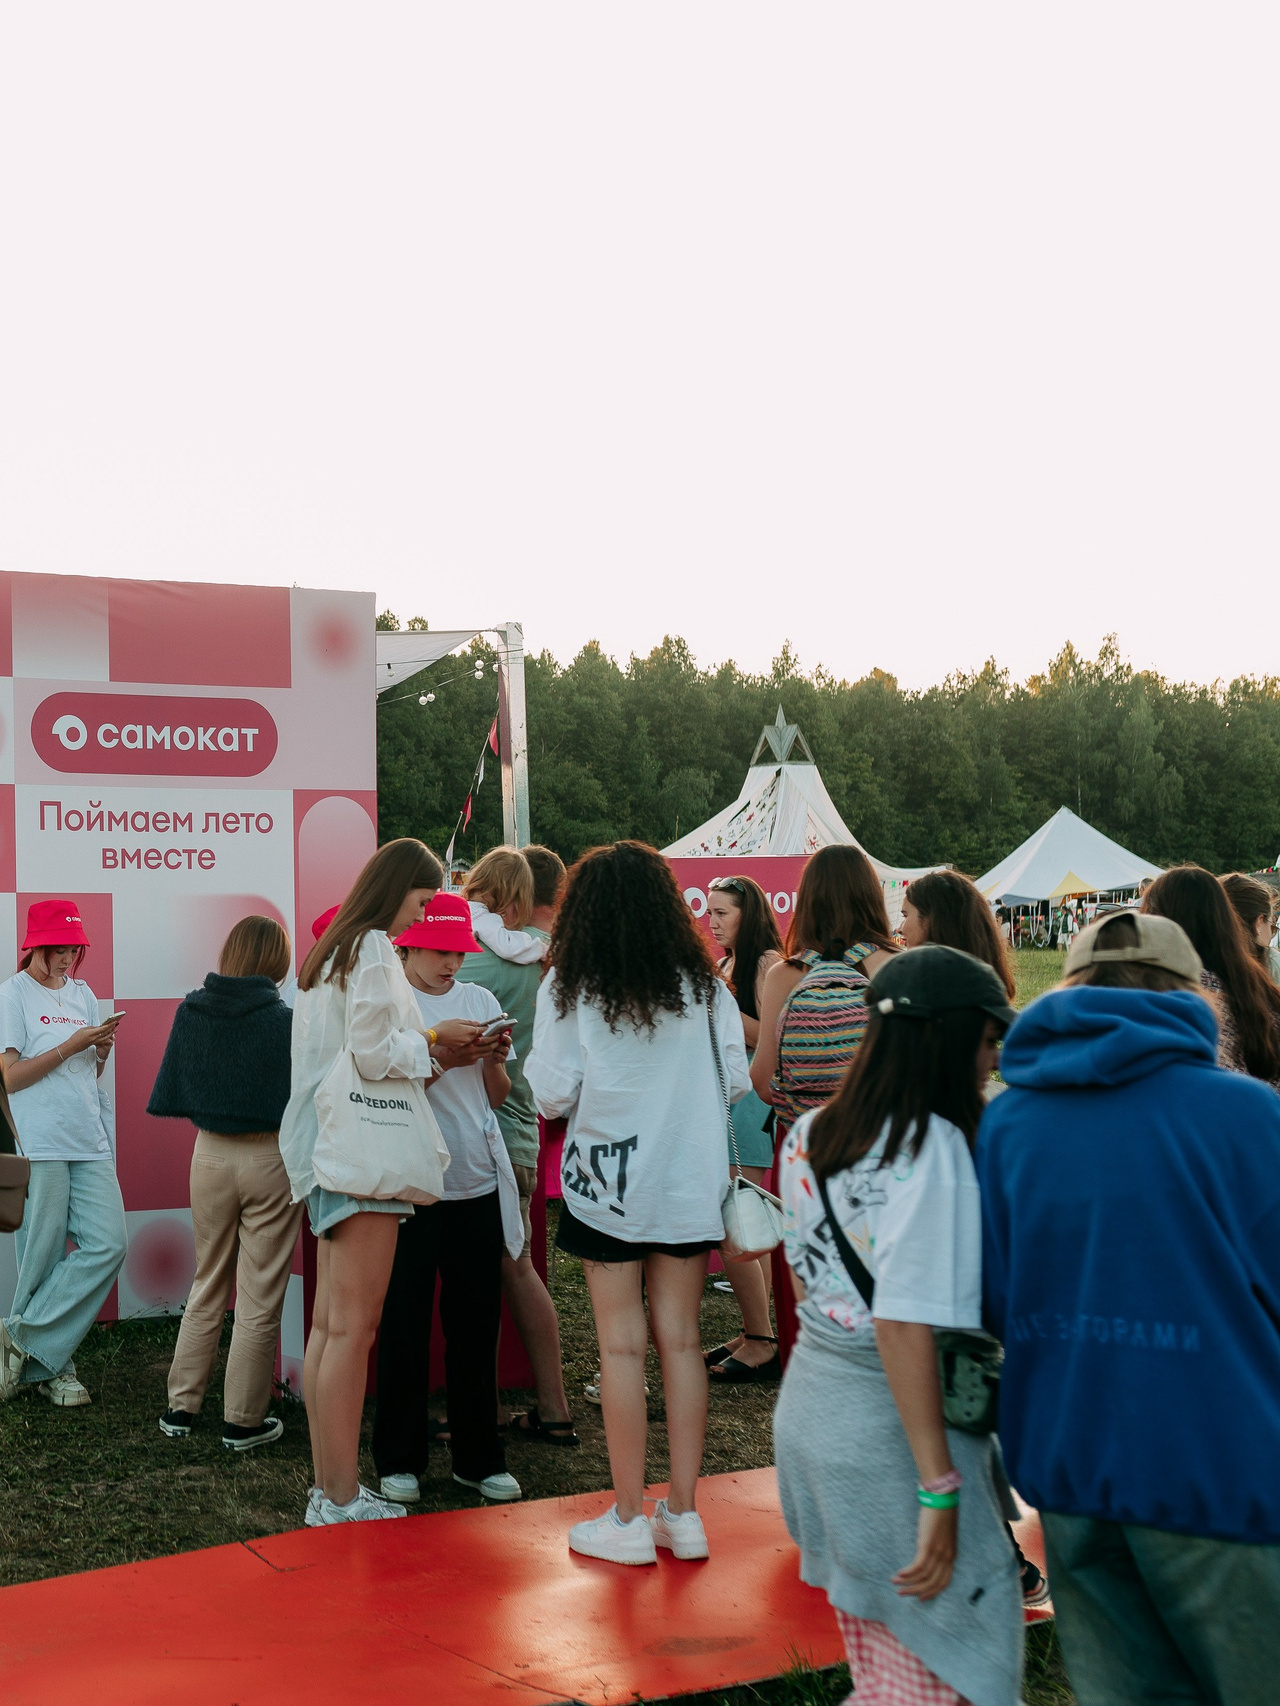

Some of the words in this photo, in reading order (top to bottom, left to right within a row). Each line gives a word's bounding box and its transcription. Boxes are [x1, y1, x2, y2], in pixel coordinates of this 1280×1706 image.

[96, 722, 259, 752] самокат
[39, 800, 193, 833] Поймаем
[201, 812, 275, 834] лето
[101, 847, 216, 870] вместе
